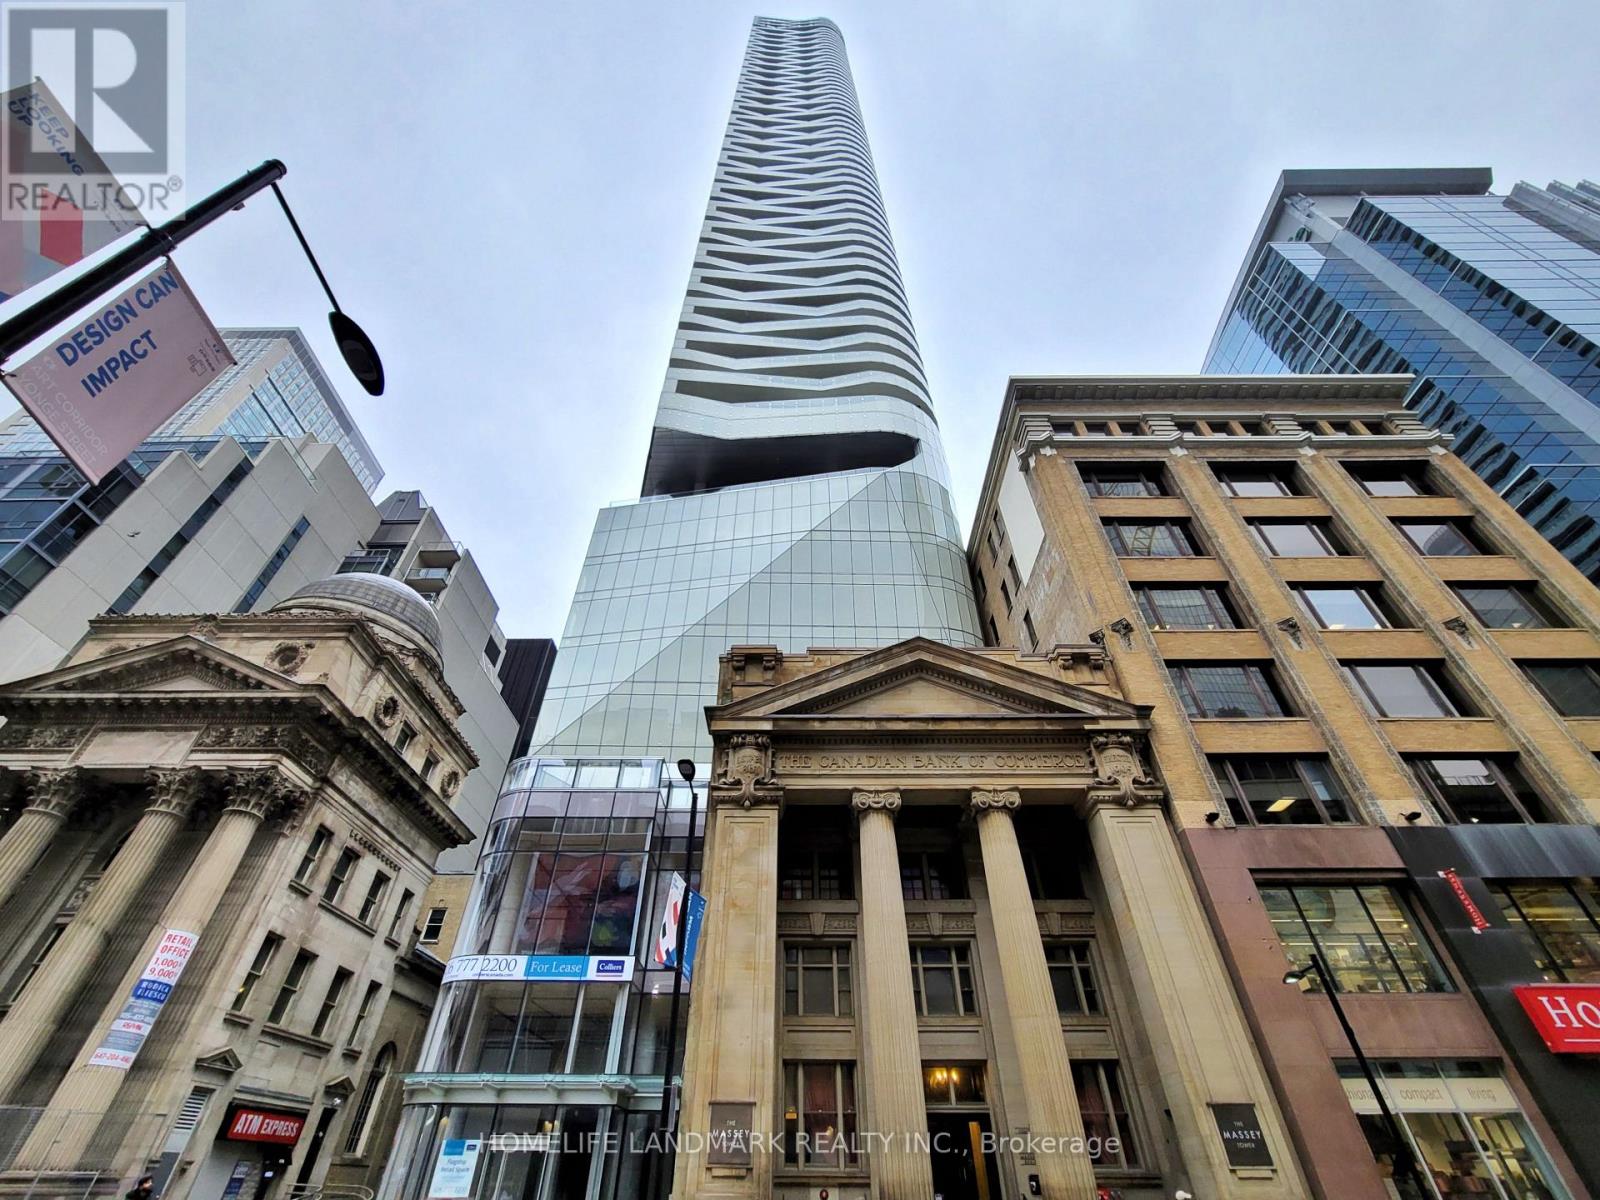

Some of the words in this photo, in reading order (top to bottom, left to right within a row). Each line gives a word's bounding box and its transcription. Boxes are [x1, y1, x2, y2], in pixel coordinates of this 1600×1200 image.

[8, 100, 33, 127] UP
[31, 92, 69, 138] KEEP
[18, 97, 84, 176] LOOKING
[56, 298, 138, 367] DESIGN
[135, 271, 179, 309] CAN
[81, 329, 157, 398] IMPACT
[55, 392, 108, 457] CORRIDOR
[779, 755, 812, 769] THE
[818, 755, 908, 769] CANADIAN
[912, 755, 963, 769] BANK
[968, 755, 988, 769] OF
[993, 755, 1086, 769] COMMERCE
[165, 933, 192, 947] RETAIL
[160, 945, 190, 959] OFFICE
[457, 957, 479, 972] 777
[480, 957, 518, 972] 2200
[530, 961, 549, 973] For
[552, 961, 582, 973] Lease
[599, 963, 623, 971] Colliers
[1400, 1087, 1445, 1104] compact
[1466, 1087, 1497, 1103] living
[233, 1113, 264, 1135] ATM
[260, 1118, 299, 1138] EXPRESS
[712, 1129, 750, 1139] MASSEY
[1223, 1130, 1261, 1140] MASSEY
